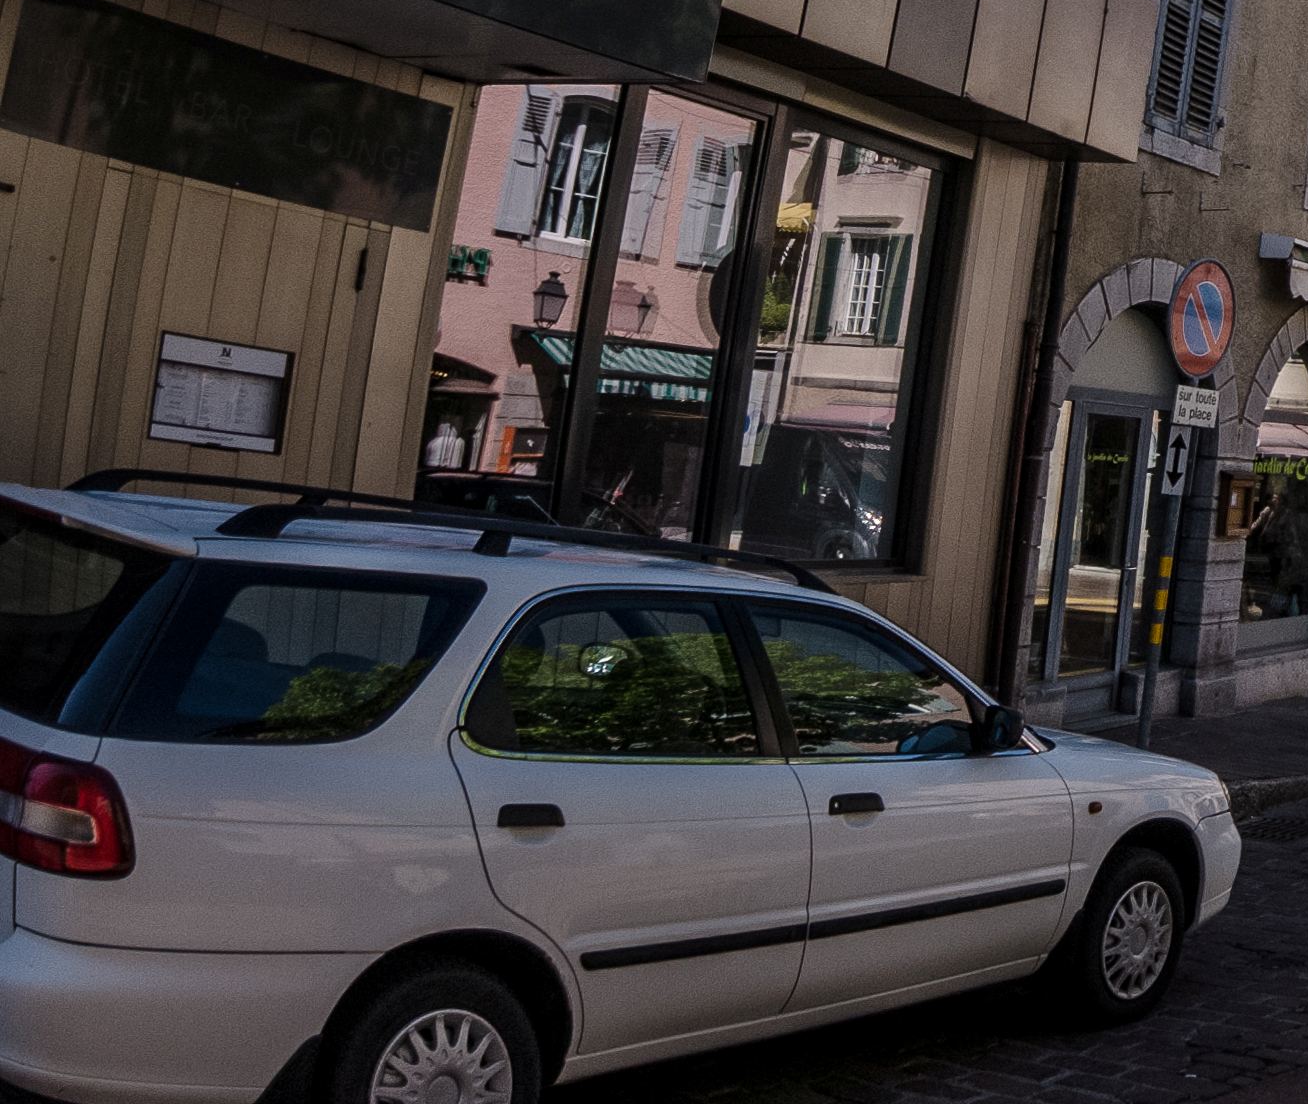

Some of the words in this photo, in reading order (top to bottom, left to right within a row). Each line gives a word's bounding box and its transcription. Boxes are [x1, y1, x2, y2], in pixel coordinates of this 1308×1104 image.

[188, 90, 252, 133] BAR
[292, 119, 421, 176] LOUNGE
[1178, 391, 1193, 401] sur
[1196, 391, 1217, 405] toute
[1178, 403, 1187, 417] la
[1189, 407, 1212, 420] place
